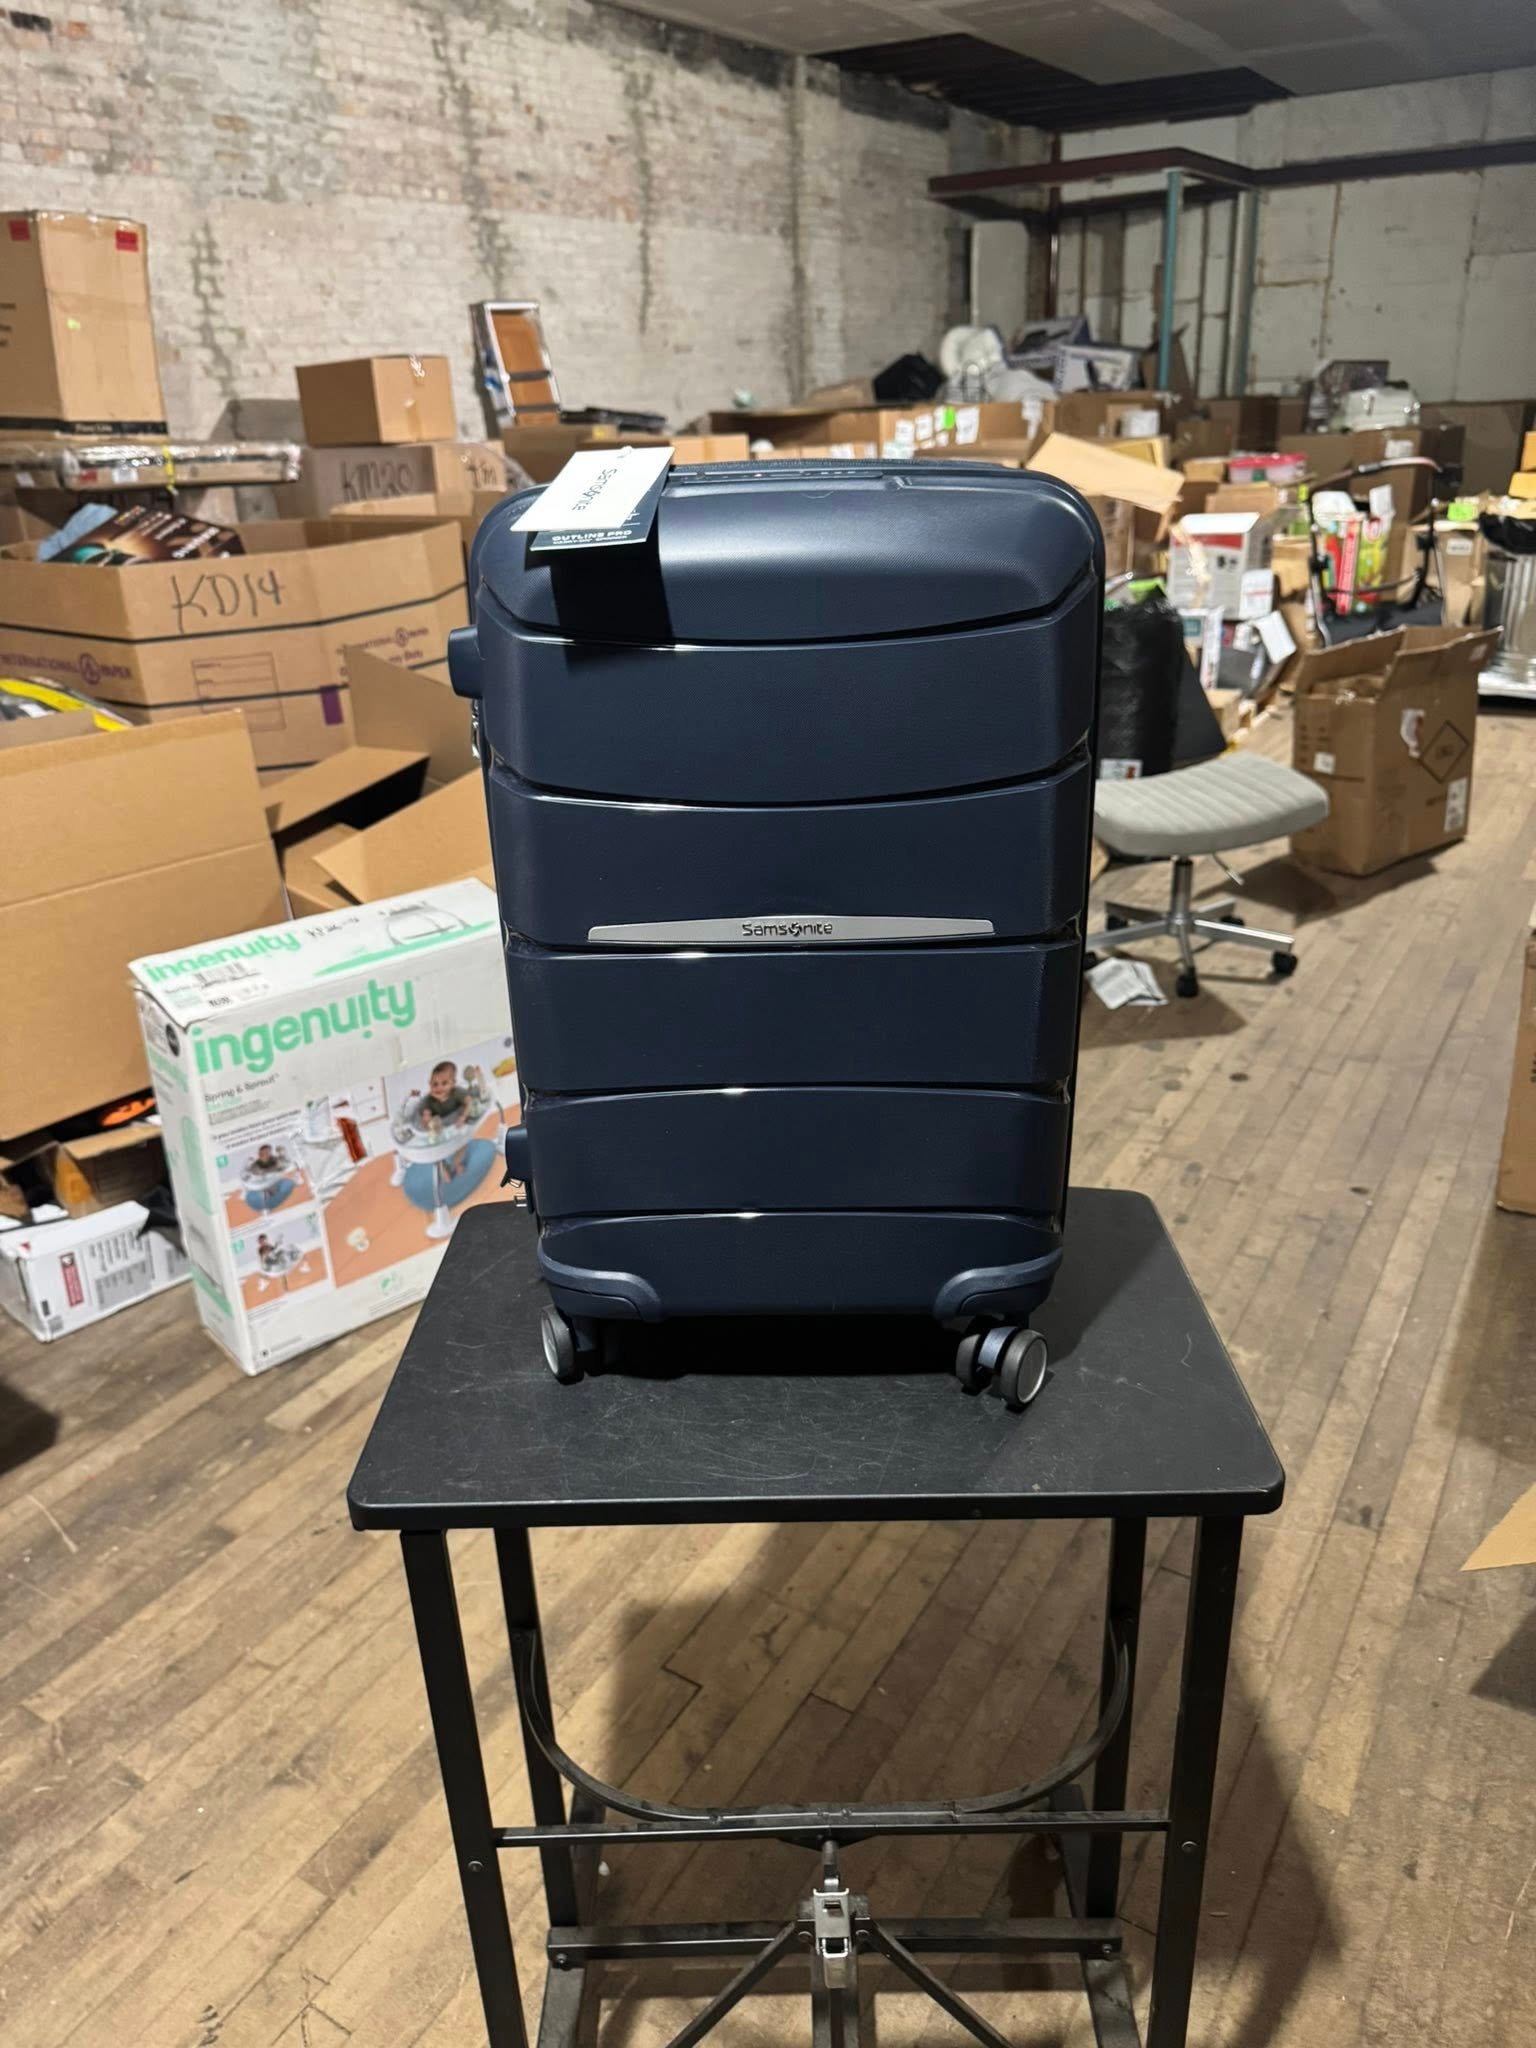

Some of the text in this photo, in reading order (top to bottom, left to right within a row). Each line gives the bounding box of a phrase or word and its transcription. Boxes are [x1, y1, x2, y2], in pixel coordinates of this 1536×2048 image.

[551, 529, 633, 542] OUTLINE PRO
[171, 569, 286, 635] KD14
[144, 929, 302, 983] ingenuity
[742, 922, 834, 937] Samsonite
[190, 978, 417, 1074] ingenuity
